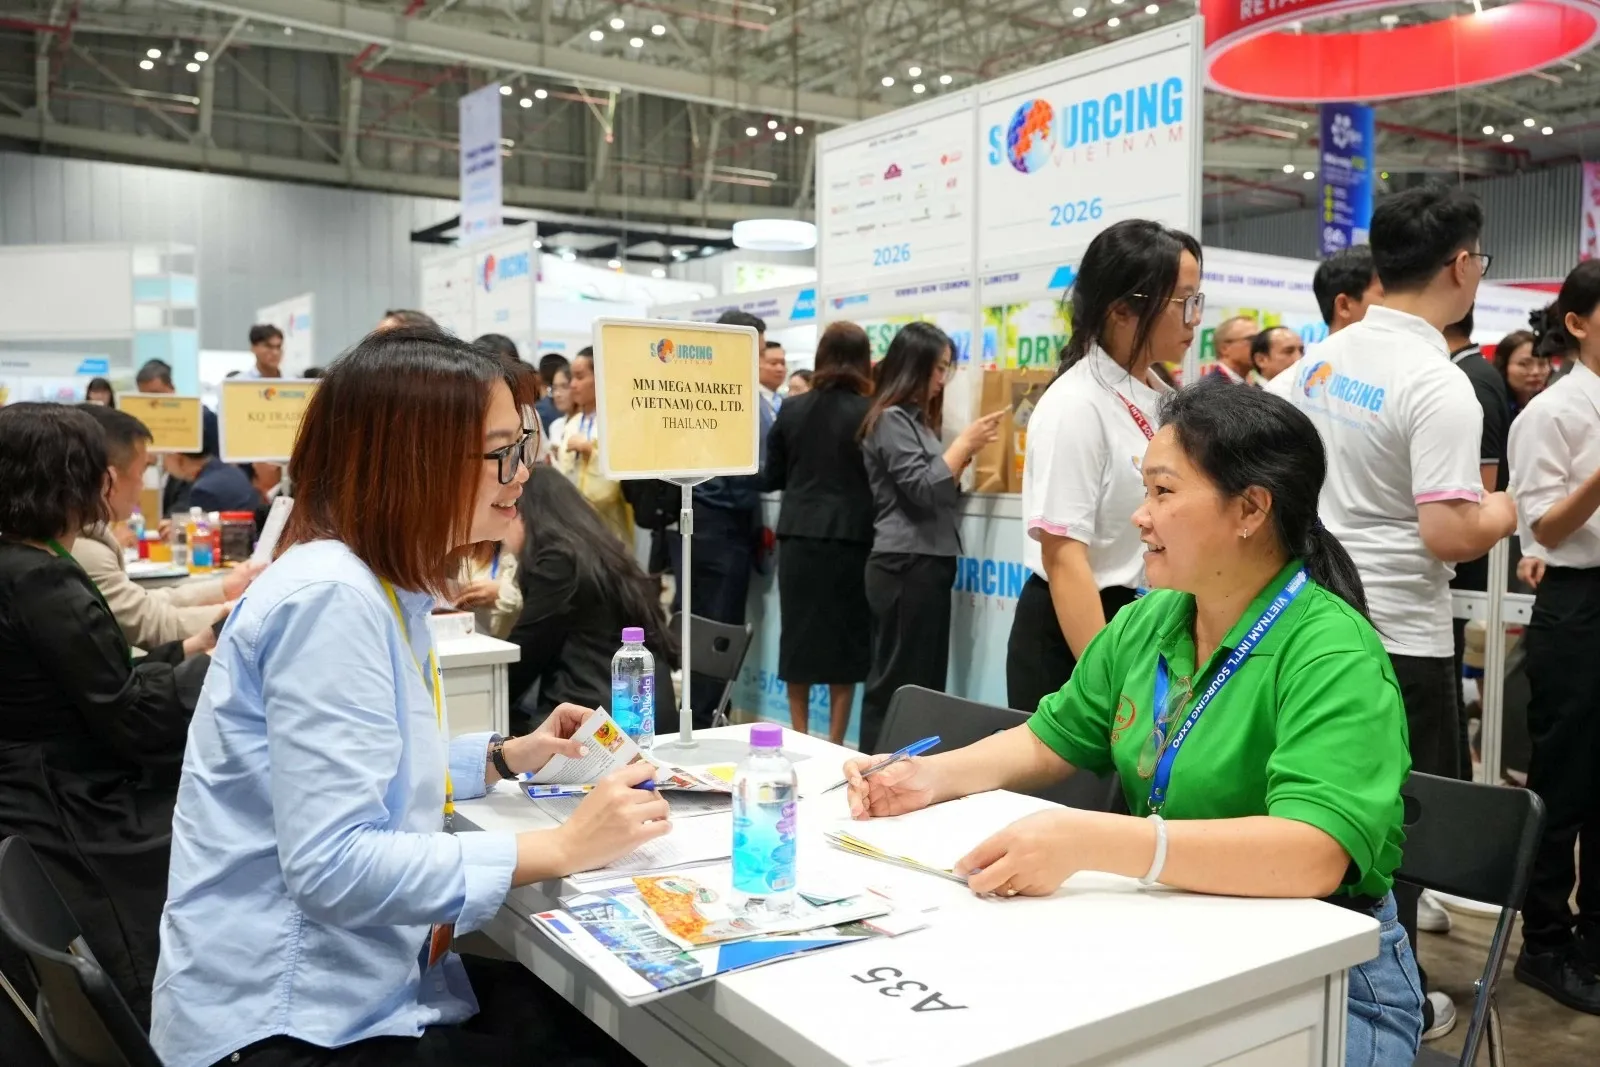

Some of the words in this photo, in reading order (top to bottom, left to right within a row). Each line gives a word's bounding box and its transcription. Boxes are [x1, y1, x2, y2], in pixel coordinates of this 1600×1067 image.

[988, 76, 1184, 171] SOURCING
[1053, 126, 1184, 168] VIETNAM
[1049, 198, 1103, 227] 2026
[873, 243, 911, 267] 2026
[650, 338, 713, 363] SOURCING
[633, 378, 655, 391] MM
[658, 380, 692, 393] MEGA
[694, 382, 743, 395] MARKET
[631, 397, 694, 412] (VIETNAM)
[696, 400, 718, 412] CO.,
[720, 400, 745, 412] LTD.
[662, 417, 718, 430] THAILAND
[1247, 597, 1288, 642] VIETNAM
[1227, 640, 1251, 666] INT'L
[1191, 666, 1231, 719] SOURCING
[1172, 721, 1193, 749] EXPO
[850, 966, 969, 1012] A35
